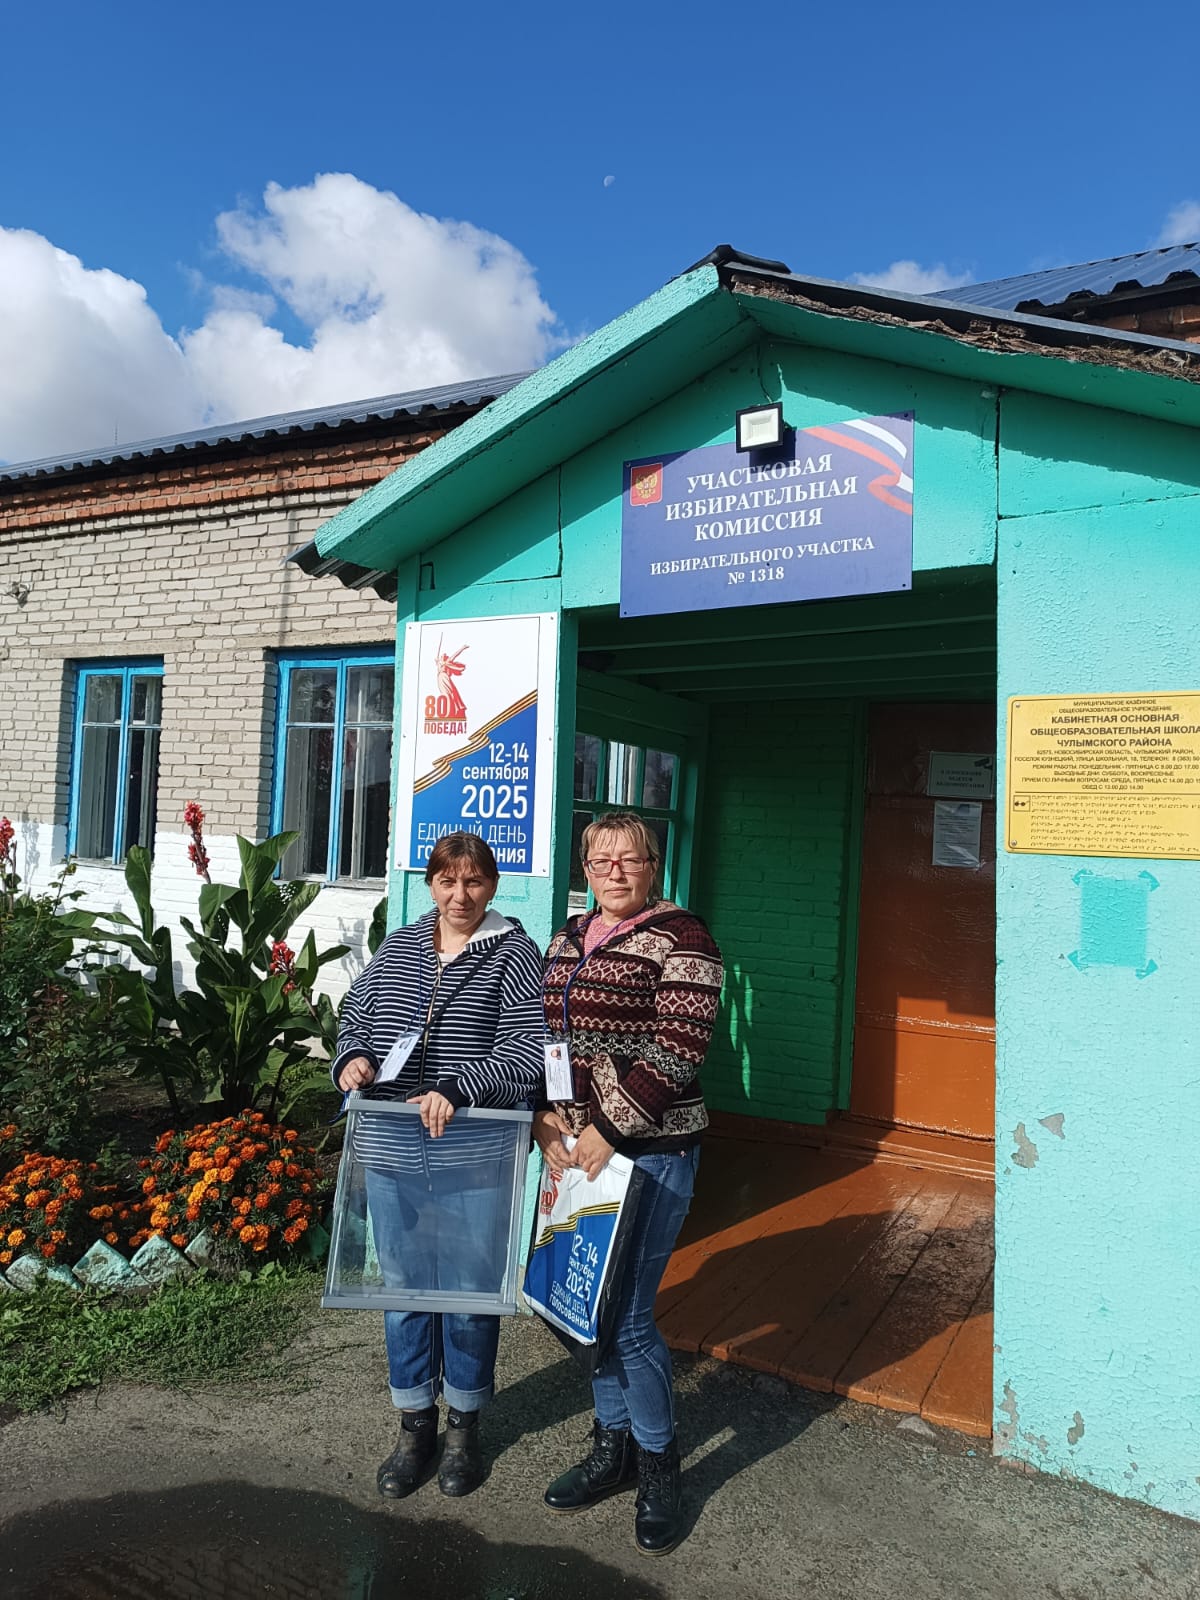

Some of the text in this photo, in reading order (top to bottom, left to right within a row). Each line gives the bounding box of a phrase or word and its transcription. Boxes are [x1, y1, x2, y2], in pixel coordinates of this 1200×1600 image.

[687, 453, 832, 494] УЧАСТКОВАЯ
[665, 476, 858, 521] ИЗБИРАТЕЛЬНАЯ
[694, 508, 823, 542] КОМИССИЯ
[650, 536, 874, 576] ИЗБИРАТЕЛЬНОГО УЧАСТКА
[728, 567, 784, 585] № 1318
[425, 695, 448, 718] 80
[424, 722, 467, 736] ПОБЕДА!
[1051, 714, 1179, 724] КАБИНЕТНАЯ ОСНОВНАЯ
[1030, 725, 1200, 736] ОБЩЕОБРАЗОВАТЕЛЬНАЯ ШКОЛА
[488, 742, 529, 763] 12-14
[1057, 737, 1172, 747] ЧУЛЫМСКОГО РАЙОНА
[462, 763, 529, 783] сентября
[461, 784, 528, 819] 2025
[486, 825, 527, 845] ДЕНЬ
[571, 1232, 598, 1268] 12-14
[565, 1267, 592, 1302] 2025
